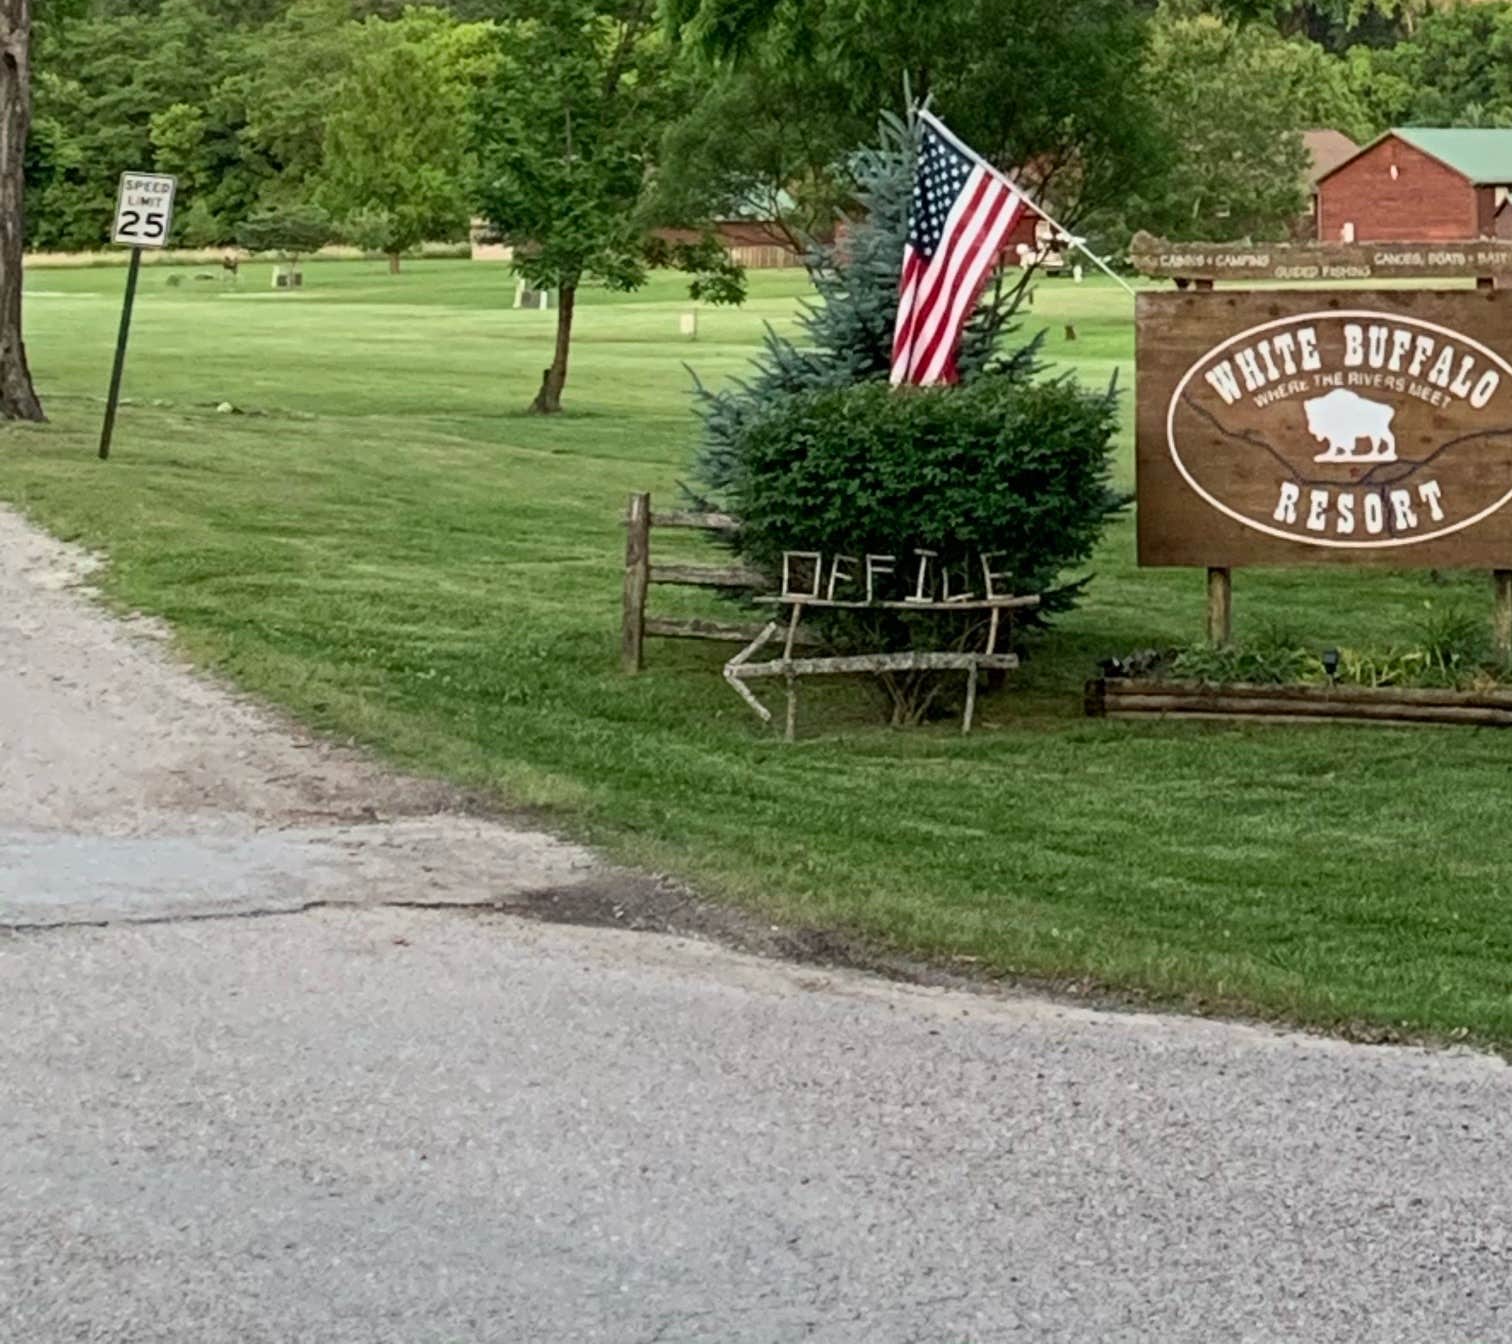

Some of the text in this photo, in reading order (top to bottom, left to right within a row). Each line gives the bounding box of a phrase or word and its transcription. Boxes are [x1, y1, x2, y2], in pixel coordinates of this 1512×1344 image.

[126, 180, 170, 193] SPEED
[128, 196, 162, 207] LIMIT
[119, 211, 163, 238] 25
[1215, 254, 1270, 267] CAMPING
[1322, 265, 1371, 278] FISHING
[1204, 323, 1500, 409] WHITE BUFFALO
[1253, 371, 1452, 409] WHERE THE RIVERS MEET
[1273, 480, 1444, 534] RESORT
